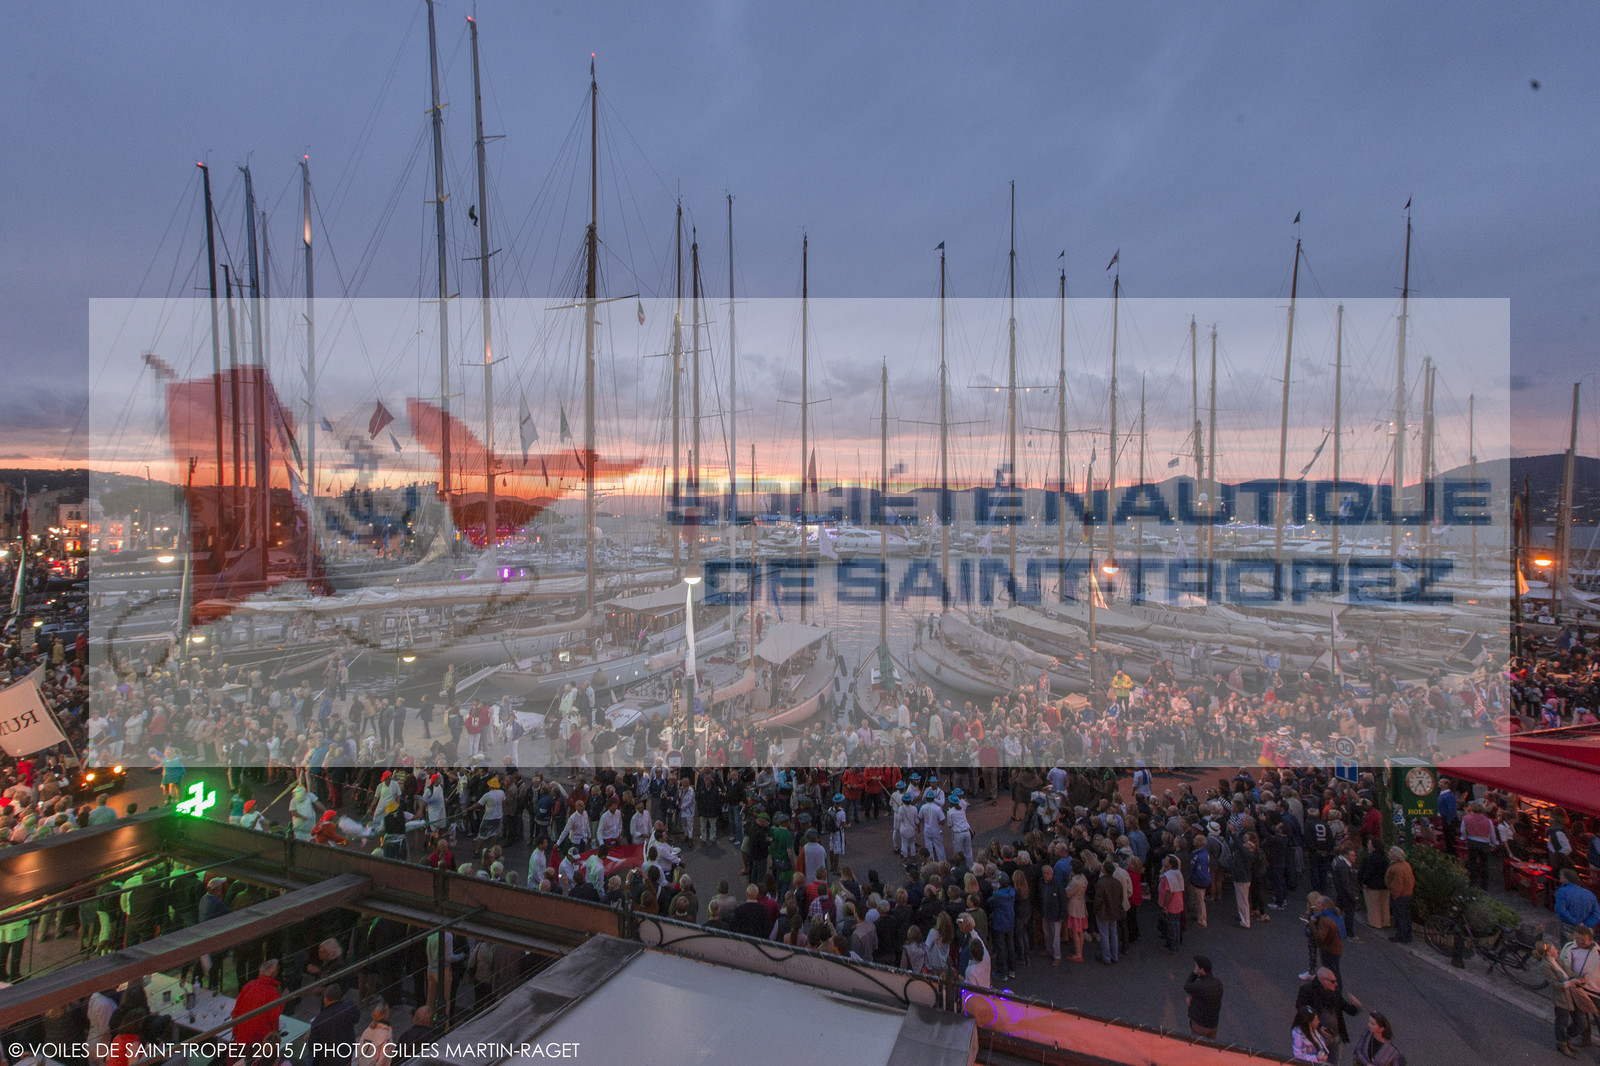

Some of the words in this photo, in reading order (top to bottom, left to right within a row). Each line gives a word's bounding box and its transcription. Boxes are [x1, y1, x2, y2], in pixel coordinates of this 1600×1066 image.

[1142, 610, 1178, 625] TUIGA
[471, 717, 479, 727] 12
[1340, 742, 1351, 752] 30
[1315, 823, 1327, 837] 9
